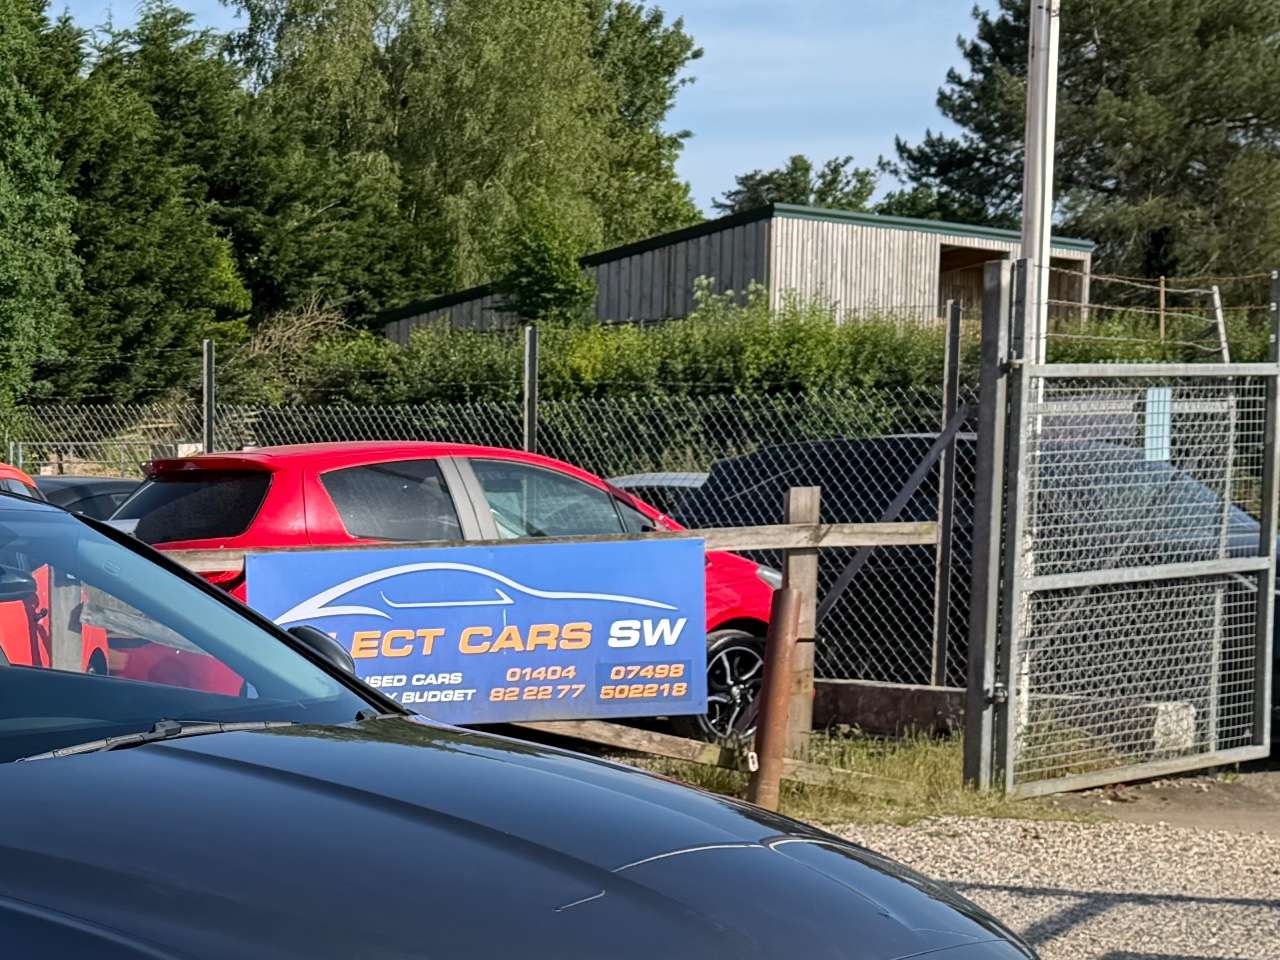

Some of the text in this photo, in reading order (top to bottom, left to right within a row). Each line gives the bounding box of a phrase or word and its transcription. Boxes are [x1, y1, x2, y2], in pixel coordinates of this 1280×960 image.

[327, 617, 687, 660] ECT CARS SW
[411, 672, 463, 687] CARS
[506, 665, 577, 682] 01404
[610, 663, 685, 680] 07498
[401, 689, 476, 704] BUDGET
[600, 682, 688, 699] 502218
